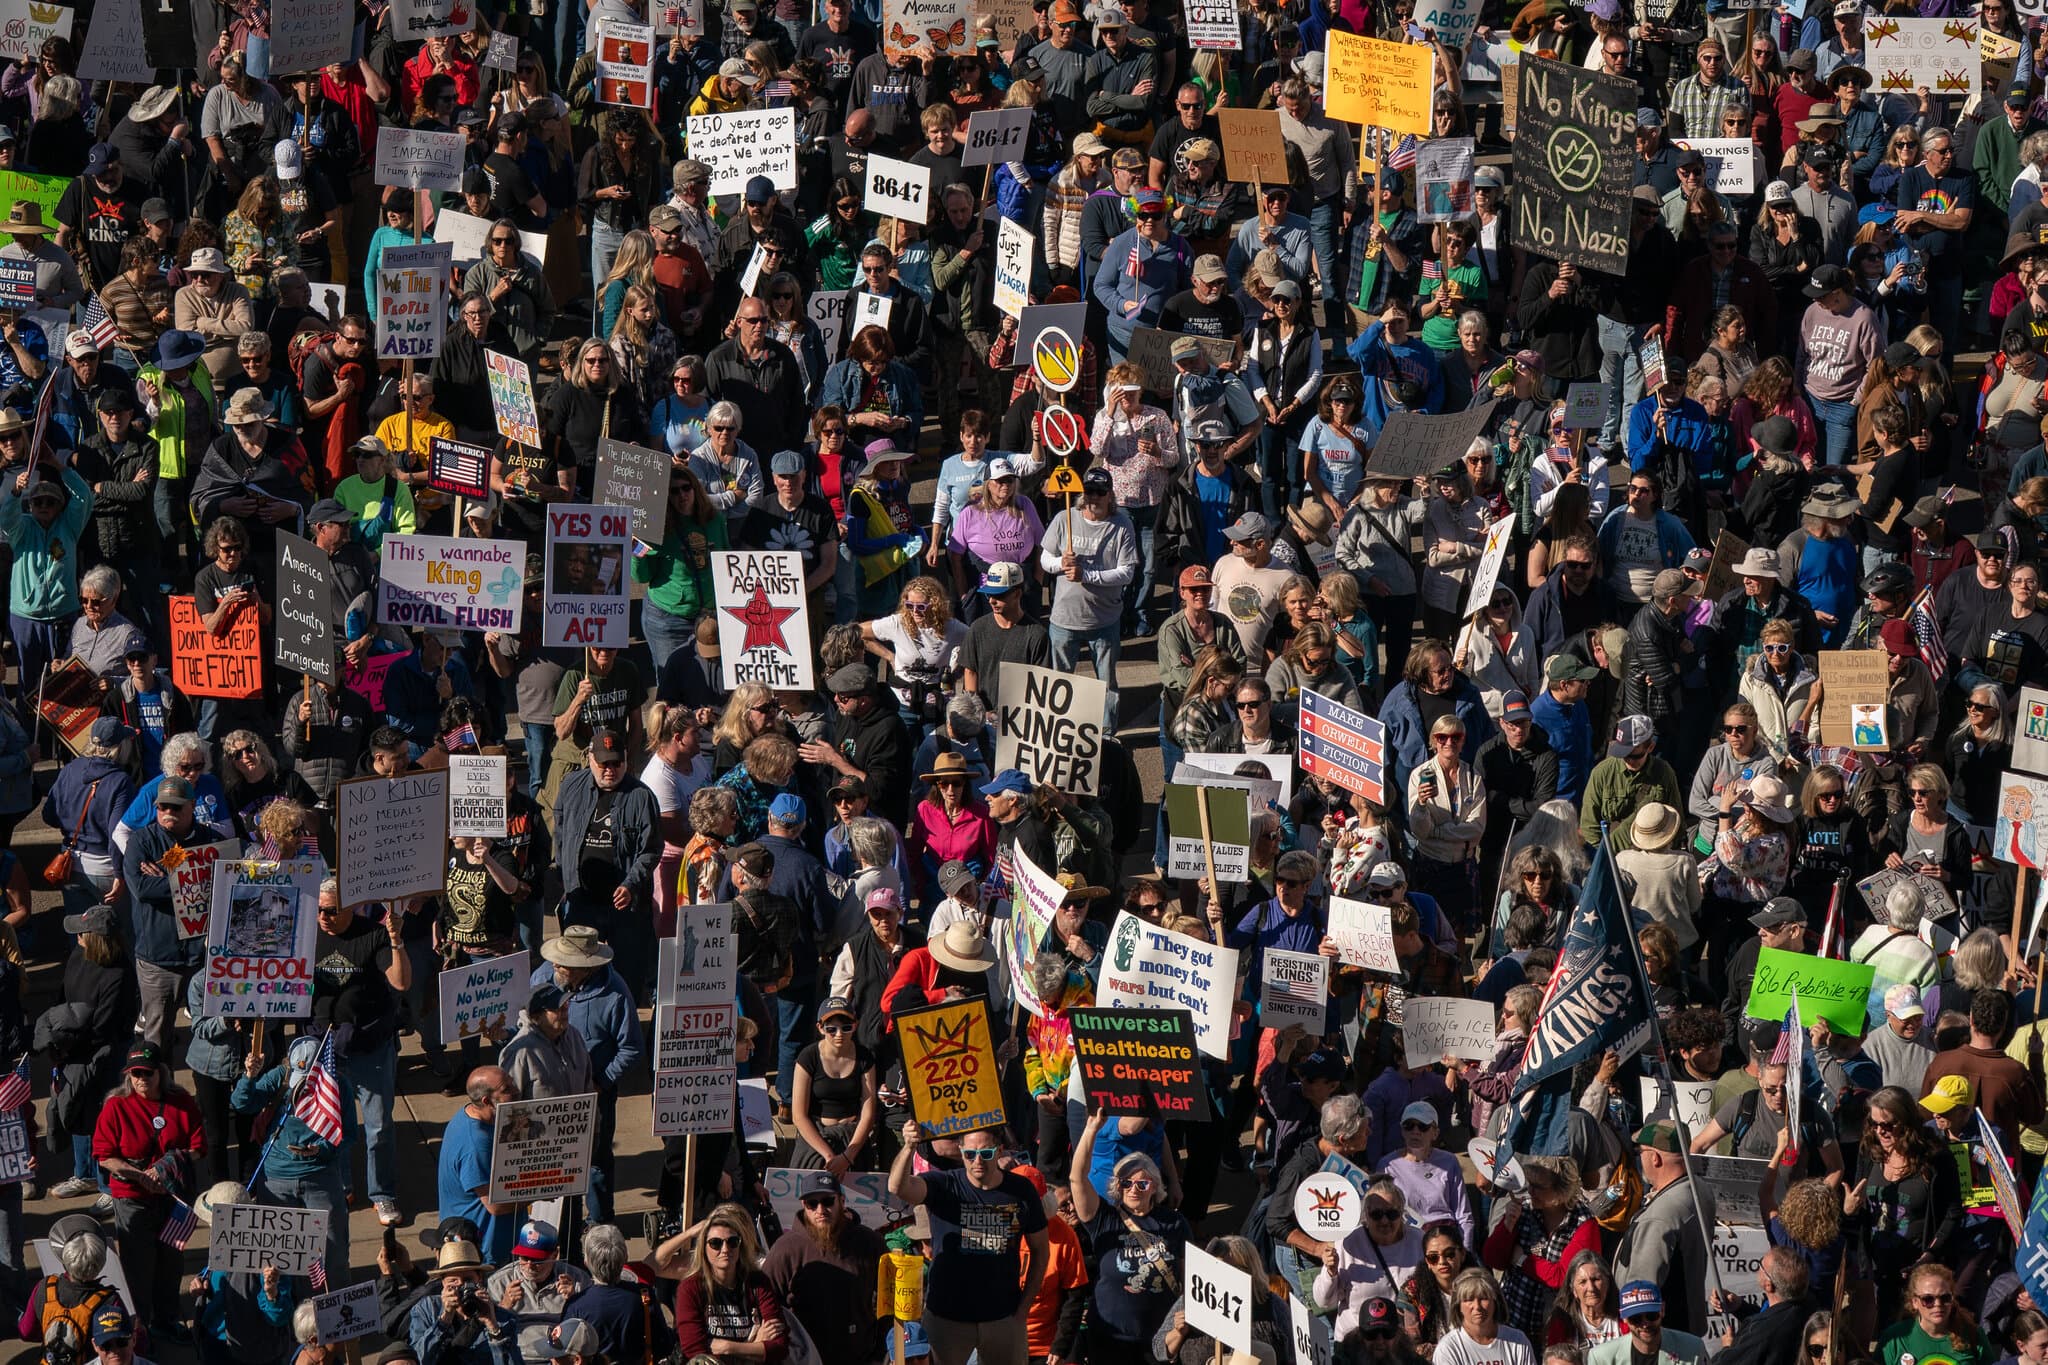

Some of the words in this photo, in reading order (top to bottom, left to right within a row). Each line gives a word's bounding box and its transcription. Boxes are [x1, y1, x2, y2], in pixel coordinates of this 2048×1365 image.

[902, 1, 957, 15] MONARCH
[1192, 8, 1233, 24] OFF!
[1425, 10, 1477, 28] ABOVE
[1437, 31, 1466, 48] THE
[1899, 31, 1937, 49] NO
[1983, 34, 1998, 45] KIDS
[872, 84, 911, 93] DUKE
[1525, 67, 1562, 118] No
[1570, 77, 1637, 145] Kings
[690, 115, 723, 135] 250
[730, 117, 761, 133] years
[767, 114, 789, 130] ago
[1228, 123, 1266, 137] DUMP
[972, 126, 1022, 149] 8647
[391, 146, 452, 161] IMPEACH
[1230, 150, 1278, 165] TRUMP
[876, 174, 923, 204] 8647
[100, 217, 119, 229] NO
[1520, 193, 1555, 246] No
[1563, 203, 1629, 257] Nazis
[89, 228, 129, 243] KINGS
[998, 233, 1022, 257] Just
[387, 251, 419, 263] Planet
[420, 250, 450, 263] Trump
[1006, 255, 1022, 275] Try
[17, 269, 34, 281] YET?
[996, 265, 1027, 297] VIAGRA
[382, 297, 430, 315] PEOPLE
[382, 334, 433, 355] ABIDE
[1811, 325, 1833, 340] LET'S
[1836, 328, 1851, 345] BE
[1808, 341, 1847, 364] BETTER
[486, 351, 527, 381] LOVE
[491, 383, 532, 410] MAKES
[499, 416, 538, 446] GREAT
[436, 440, 486, 459] PRO-AMERICA
[607, 443, 618, 462] The
[620, 450, 641, 466] power
[643, 453, 653, 466] of
[653, 453, 664, 475] the
[1325, 449, 1350, 461] NASTY
[1056, 471, 1073, 490] NO
[607, 480, 642, 501] STRONGER
[550, 513, 592, 538] YES
[601, 515, 627, 538] ON
[388, 541, 425, 561] This
[440, 545, 512, 564] wannabe
[993, 541, 1025, 553] TRUMP
[281, 544, 324, 583] America
[727, 554, 793, 577] RAGE
[427, 561, 483, 595] King
[732, 577, 800, 596] AGAINST
[281, 597, 325, 638] Country
[387, 602, 448, 625] ROYAL
[455, 606, 514, 629] FLUSH
[546, 602, 585, 616] VOTING
[590, 602, 625, 616] RIGHTS
[301, 632, 312, 645] of
[563, 617, 607, 643] ACT
[178, 629, 207, 651] DONT
[211, 630, 241, 651] GIVE
[242, 630, 257, 651] UP
[276, 637, 331, 676] Immigrants
[749, 649, 780, 665] THE
[176, 656, 206, 687] THE
[206, 656, 258, 689] FIGHT
[591, 690, 628, 706] REGISTER
[1024, 671, 1074, 716] NO
[1327, 705, 1364, 731] MAKE
[1001, 704, 1099, 759] KINGS
[1321, 724, 1370, 756] ORWELL
[459, 759, 498, 768] HISTORY
[1014, 743, 1093, 794] EVER
[1322, 743, 1369, 775] FICTION
[467, 773, 490, 781] EYES
[1326, 767, 1365, 793] AGAIN
[349, 785, 376, 807] NO
[388, 777, 441, 801] KING
[467, 785, 490, 795] YOU
[453, 798, 463, 807] WE
[463, 798, 486, 807] AREN'T
[486, 798, 504, 807] BEING
[349, 813, 368, 829] NO
[376, 805, 423, 821] MEDALS
[453, 807, 504, 820] GOVERNED
[188, 847, 219, 868] NO
[1175, 862, 1192, 872] NOT
[1193, 862, 1206, 873] MY
[1215, 864, 1243, 875] ELIEFS
[705, 917, 722, 928] WE
[703, 937, 725, 949] ARE
[210, 957, 313, 980] SCHOOL
[702, 956, 723, 968] ALL
[1270, 957, 1321, 976] RESISTING
[466, 972, 483, 989] No
[486, 968, 515, 985] Kings
[1139, 959, 1190, 983] money
[1190, 974, 1212, 992] for
[1276, 969, 1314, 984] KINGS
[235, 982, 254, 995] OF
[256, 980, 315, 996] CHILDREN
[676, 982, 727, 993] IMMIGRANTS
[1108, 976, 1145, 997] wars
[1147, 981, 1176, 1001] but
[1178, 992, 1209, 1017] can't
[457, 993, 472, 1007] No
[474, 988, 501, 1001] Wars
[221, 1002, 237, 1013] AT
[246, 1002, 256, 1013] A
[266, 1002, 297, 1014] TIME
[455, 1010, 470, 1024] No
[472, 1000, 510, 1020] Empires
[1267, 1001, 1295, 1016] SINCE
[1297, 1003, 1318, 1018] 1776
[1410, 1001, 1457, 1018] THE
[1539, 961, 1633, 1060] KINGS
[682, 1012, 724, 1030] STOP
[1403, 1020, 1459, 1041] WRONG
[1465, 1020, 1493, 1035] ICE
[1078, 1038, 1192, 1060] Healthcare
[1416, 1040, 1430, 1056] IS
[1433, 1033, 1495, 1053] MELTING
[925, 1055, 979, 1085] 220
[659, 1073, 733, 1089] DEMOCRACY
[928, 1078, 979, 1102] Days
[535, 1103, 570, 1116] COME
[573, 1100, 592, 1112] ON
[681, 1093, 709, 1105] NOT
[948, 1099, 969, 1115] to
[548, 1112, 591, 1127] PEOPLE
[659, 1108, 729, 1125] OLIGARCHY
[920, 1108, 1004, 1137] Midterms
[507, 1141, 533, 1153] SMILE
[536, 1139, 551, 1150] ON
[553, 1136, 579, 1147] YOUR
[521, 1147, 563, 1159] BROTHER
[504, 1154, 560, 1169] EVERYBODY
[562, 1152, 579, 1162] GET
[518, 1162, 564, 1174] TOGETHER
[510, 1189, 538, 1199] RIGHT
[540, 1186, 565, 1197] NOW
[230, 1207, 312, 1231] FIRST
[1317, 1209, 1340, 1222] NO
[215, 1230, 320, 1251] AMENDMENT
[229, 1248, 307, 1271] FIRST
[1712, 1244, 1739, 1259] NO
[316, 1296, 341, 1311] RESIST
[344, 1285, 375, 1304] FASCISM
[1191, 1273, 1244, 1324] 8647
